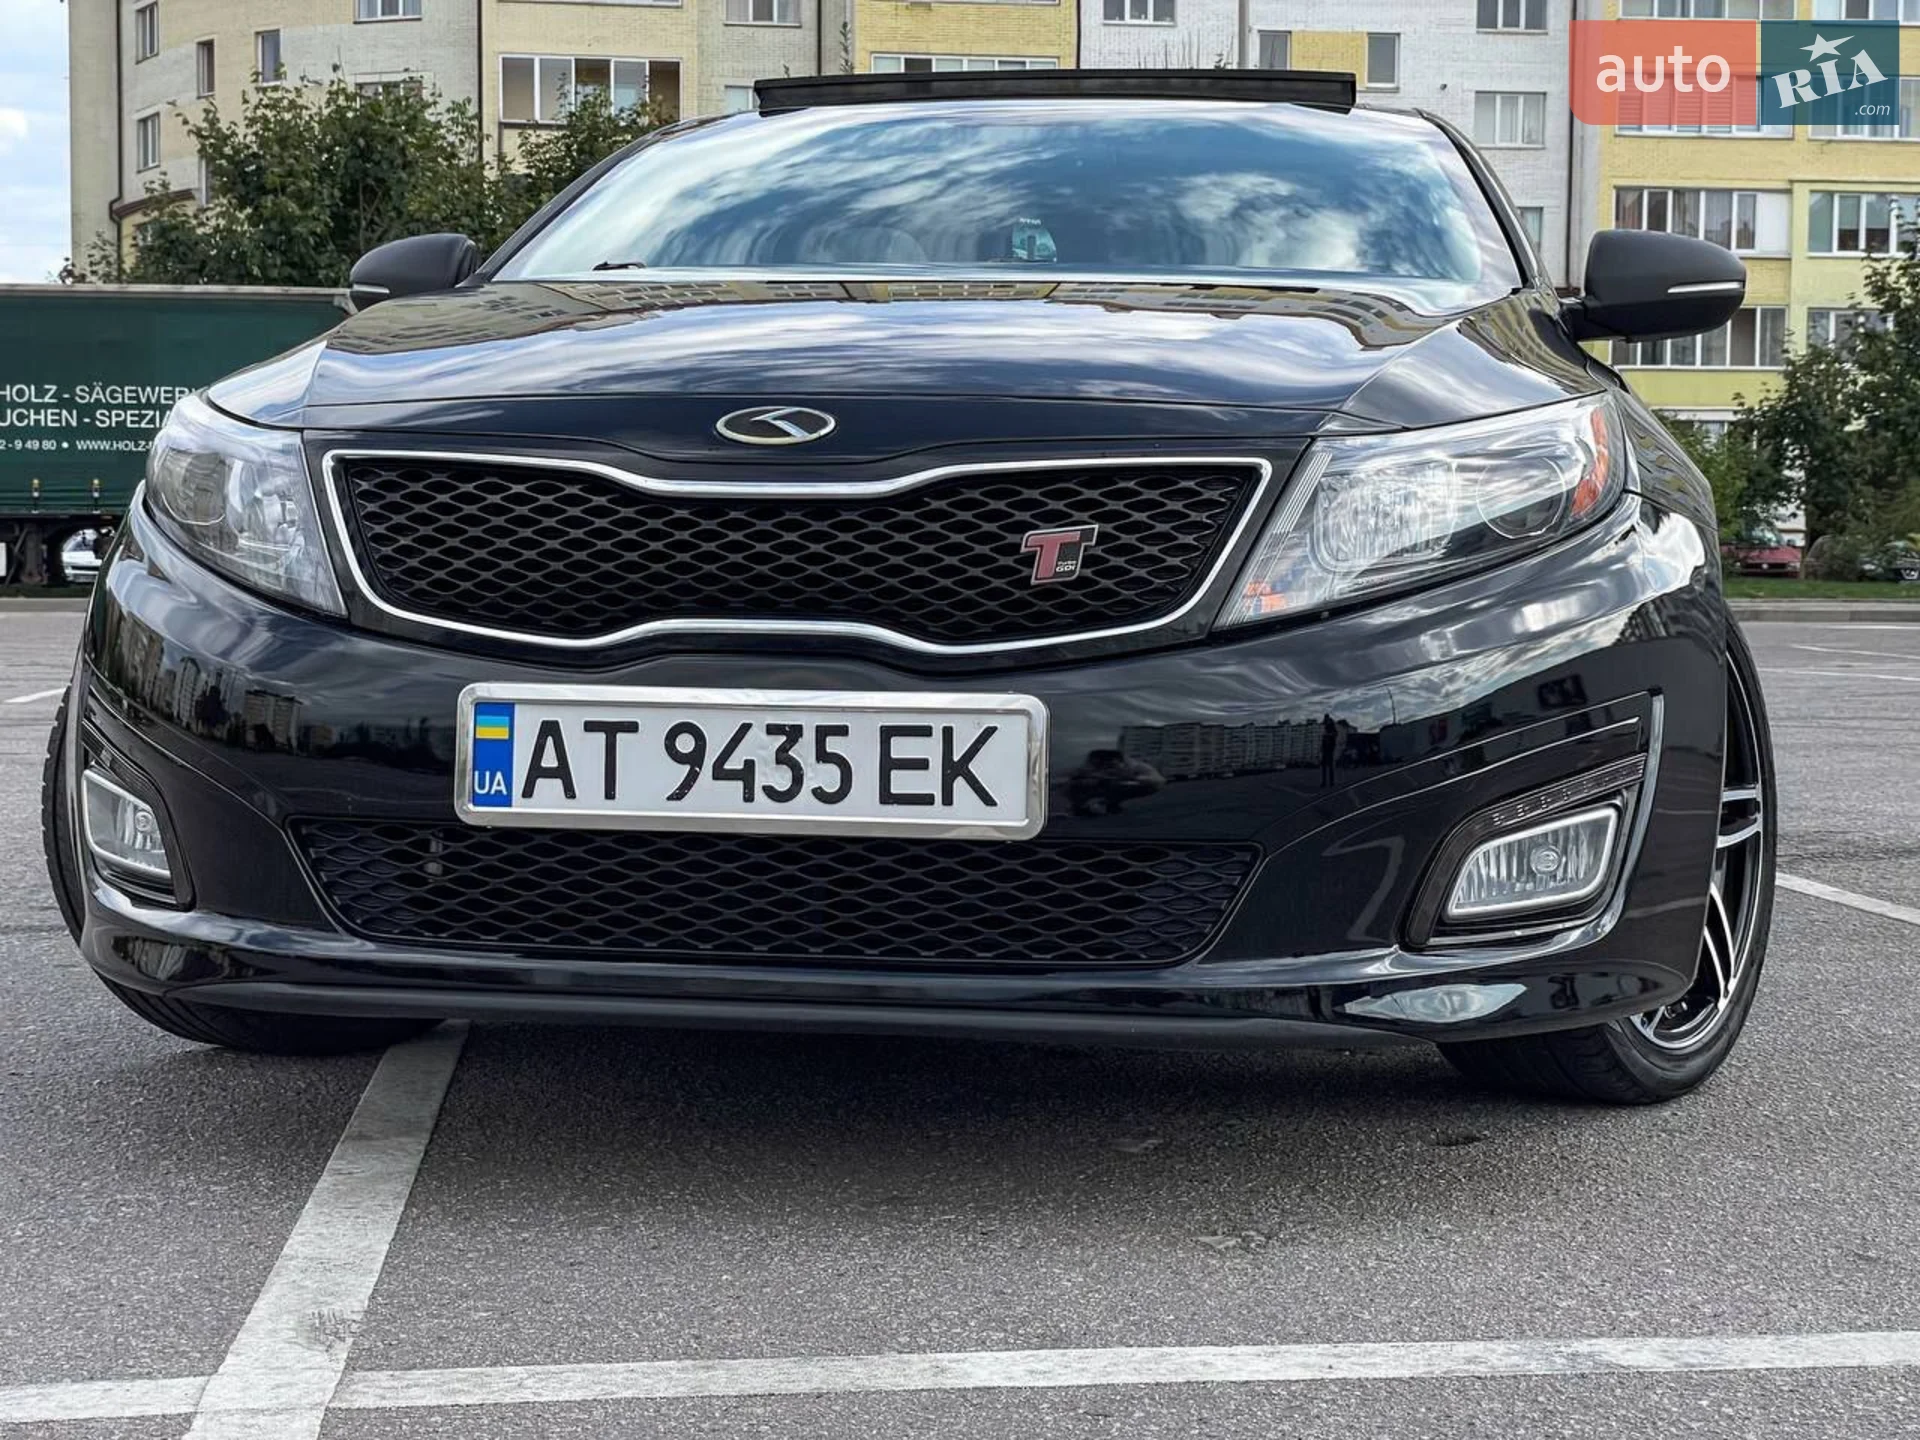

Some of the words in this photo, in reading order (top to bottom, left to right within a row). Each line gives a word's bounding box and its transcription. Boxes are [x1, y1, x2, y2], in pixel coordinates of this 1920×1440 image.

[0, 384, 58, 403] HOLZ
[75, 382, 196, 404] SÄGEWER
[474, 770, 508, 796] UA
[521, 719, 639, 801] AT
[663, 721, 853, 805] 9435
[878, 724, 998, 807] EK
